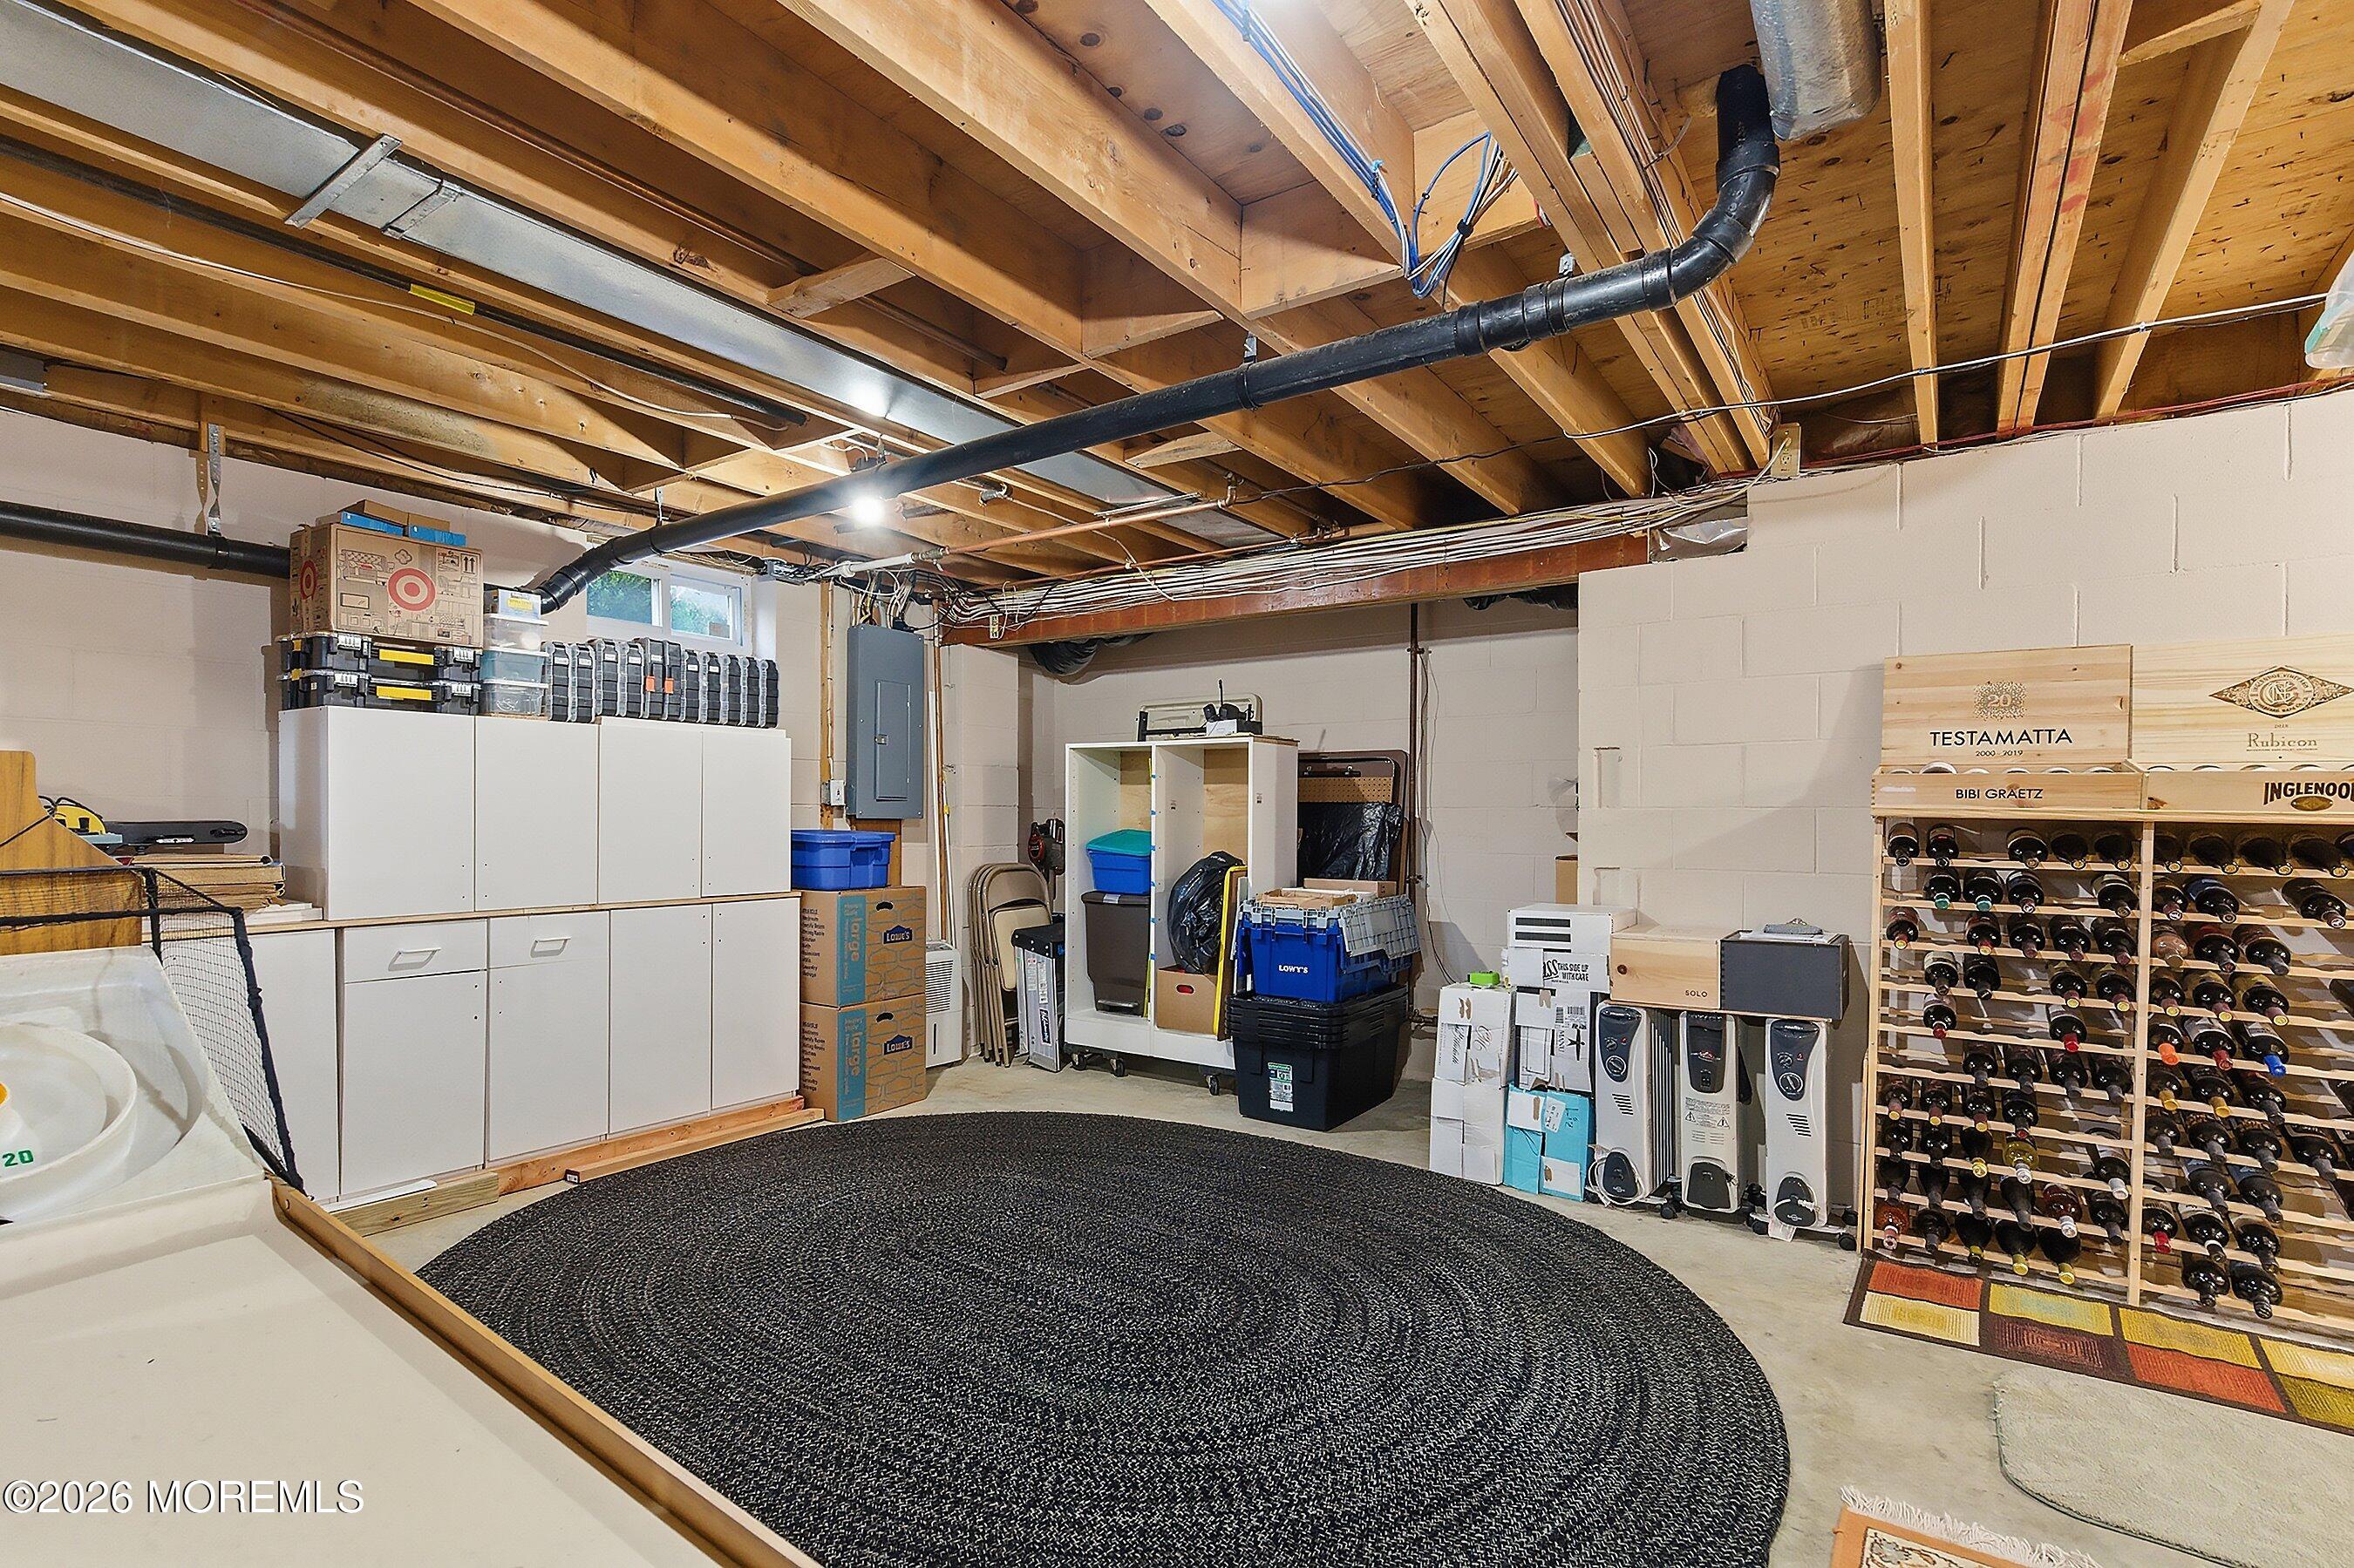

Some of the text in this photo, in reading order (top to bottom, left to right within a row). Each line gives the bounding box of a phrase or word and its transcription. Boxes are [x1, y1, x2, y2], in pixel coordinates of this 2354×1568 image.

[1988, 694, 2012, 707] 20
[1929, 729, 2073, 746] TESTAMATTA
[2247, 732, 2317, 747] Rubicon
[1956, 789, 2044, 799] BIBI GRAETZ
[3, 1151, 33, 1166] 20
